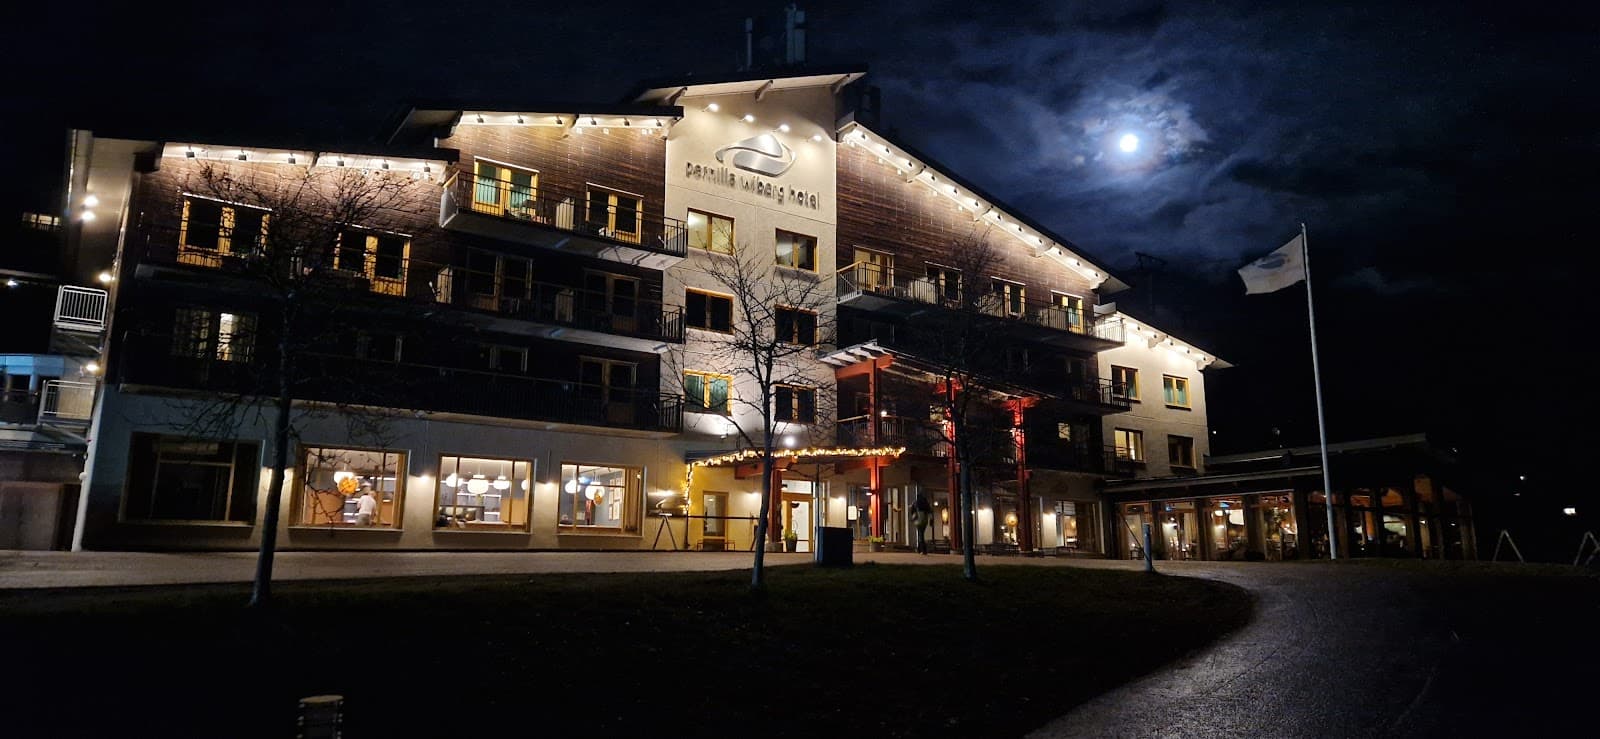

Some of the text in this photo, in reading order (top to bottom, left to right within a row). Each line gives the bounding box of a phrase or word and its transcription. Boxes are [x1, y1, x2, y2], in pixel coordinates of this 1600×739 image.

[685, 161, 820, 210] pernilla wiberg hotel
